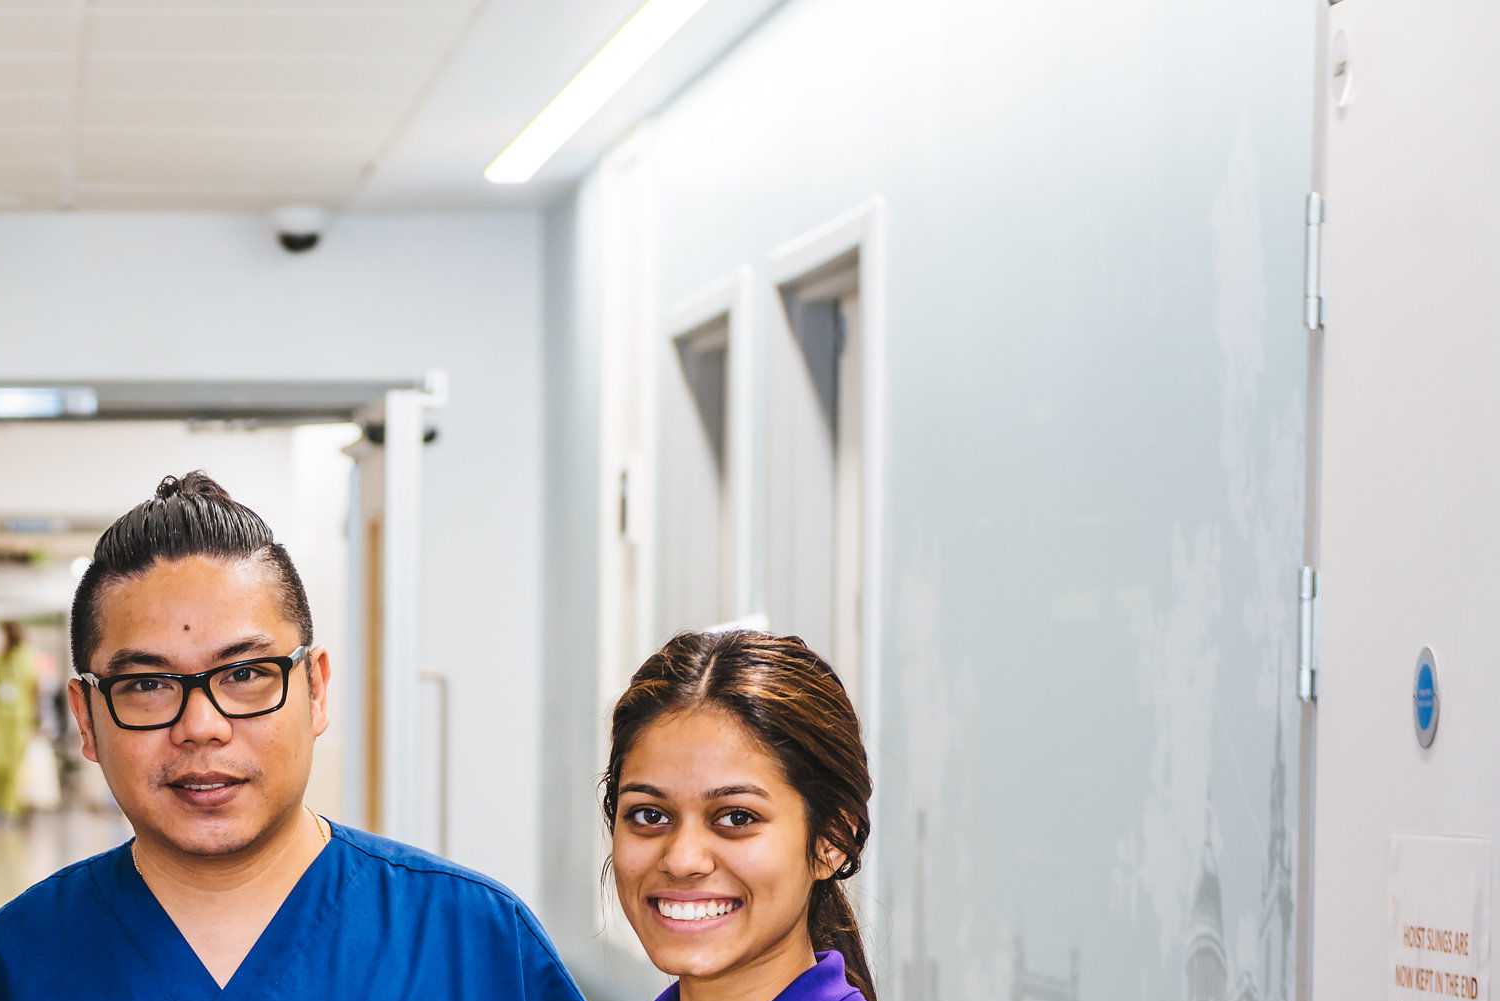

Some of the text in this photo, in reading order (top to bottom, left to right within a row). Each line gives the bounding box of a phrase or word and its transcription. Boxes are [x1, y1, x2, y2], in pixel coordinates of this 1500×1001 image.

[1427, 928, 1452, 954] SLINGS
[1454, 931, 1469, 956] ARE
[1395, 964, 1478, 1000] NOW KEPT IN THE END
